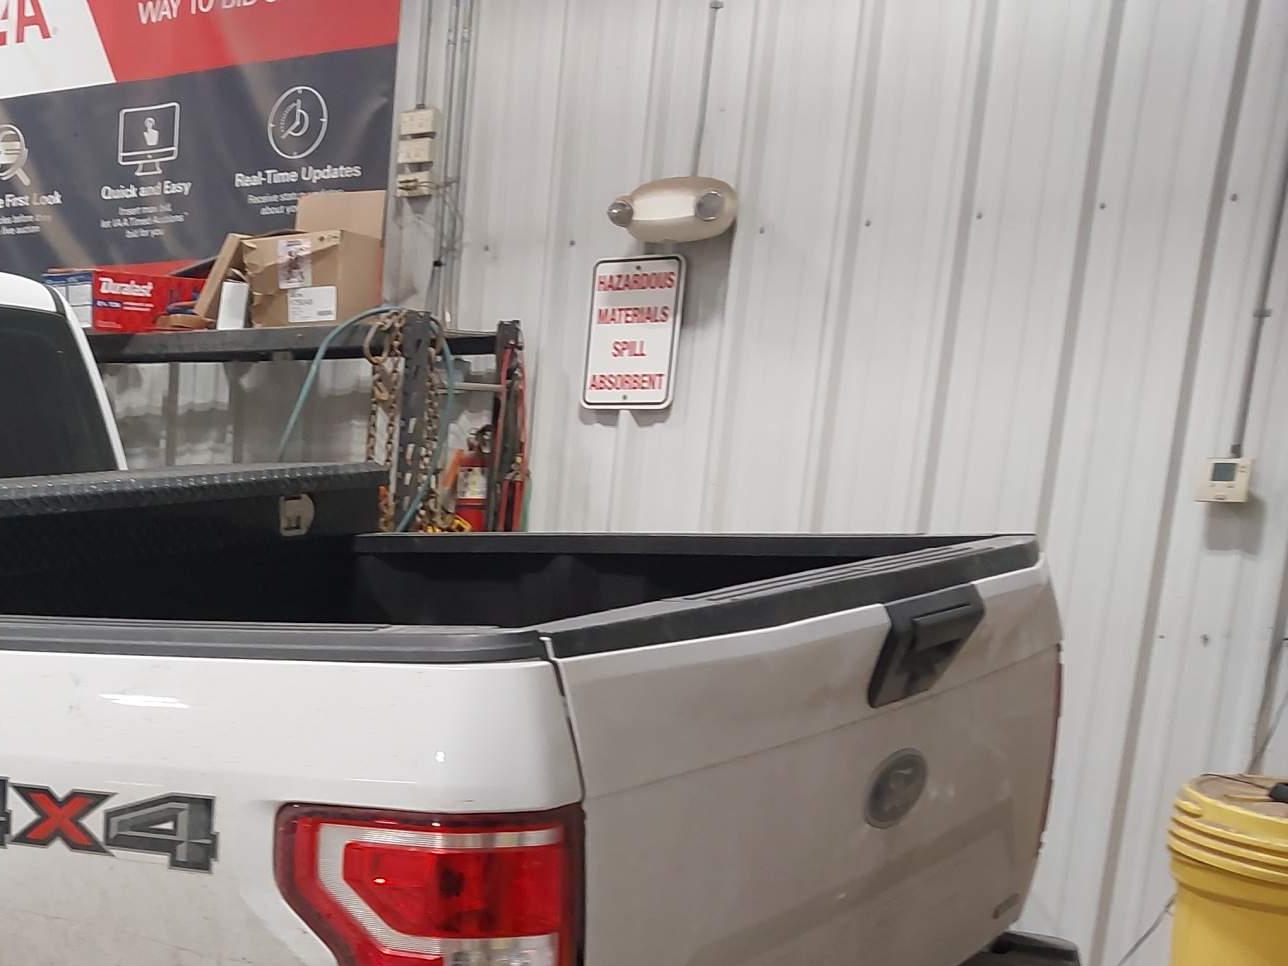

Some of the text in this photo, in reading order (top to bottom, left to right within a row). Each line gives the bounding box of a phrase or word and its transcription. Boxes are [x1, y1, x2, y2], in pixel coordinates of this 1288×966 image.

[136, 0, 179, 25] WAY
[235, 164, 362, 188] Real-Time Updates
[5, 193, 30, 208] First
[32, 190, 62, 206] Look
[101, 180, 192, 200] Quick and Easy
[98, 276, 153, 298] Duralast
[597, 271, 676, 292] HAZARDOUS
[596, 305, 670, 325] MATERIALS
[611, 340, 647, 358] SPILL
[588, 372, 665, 391] ABSORBENT
